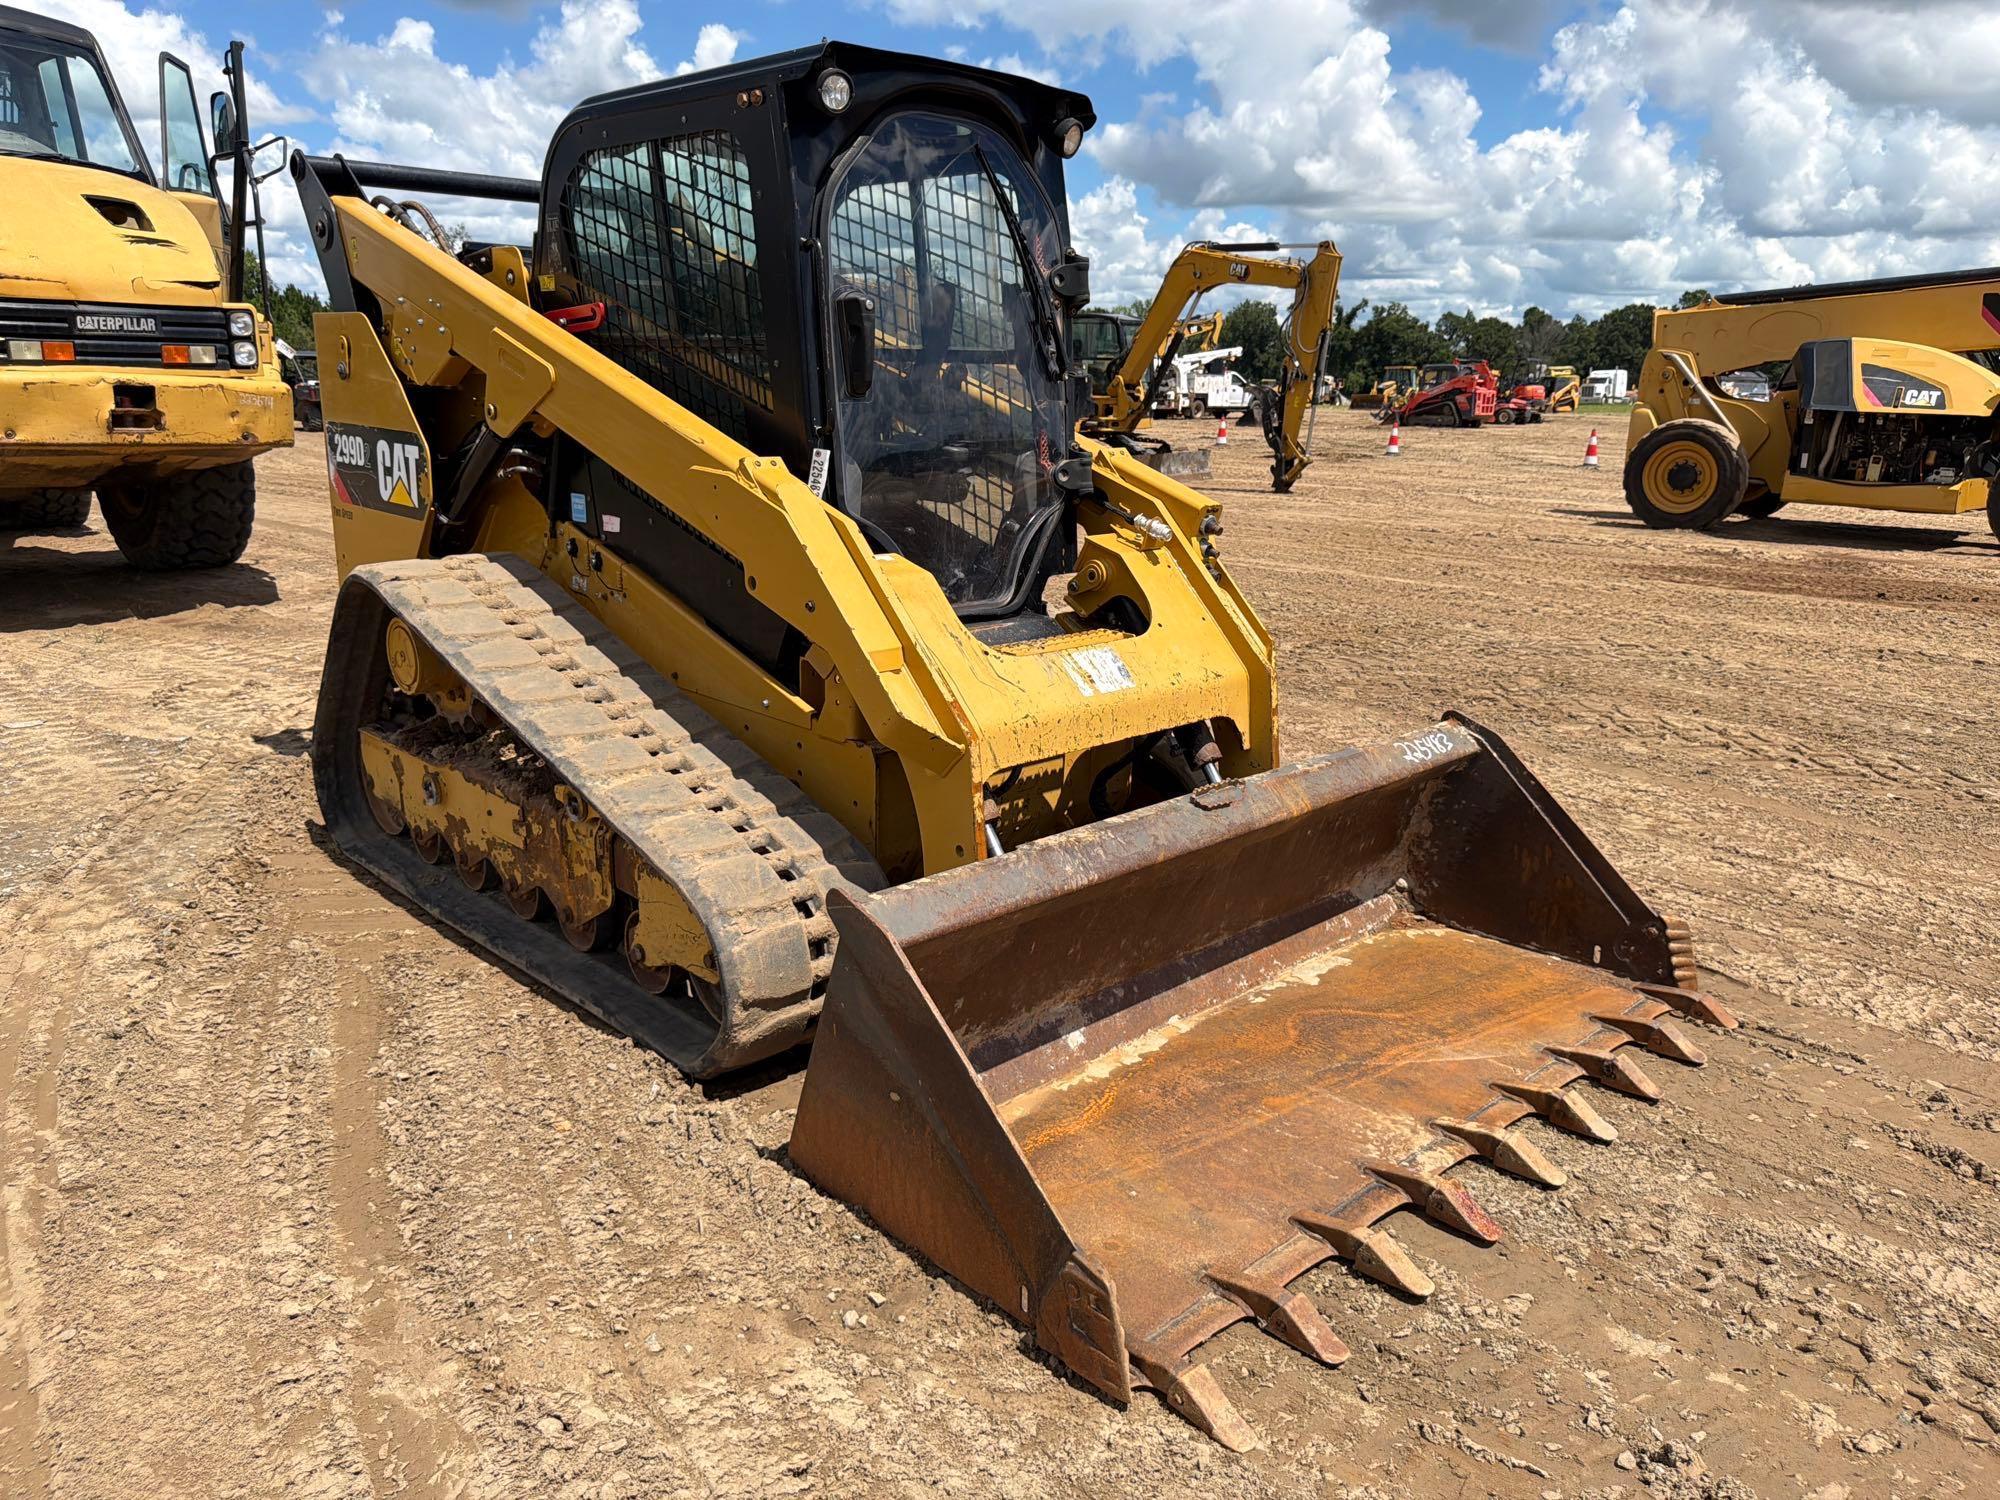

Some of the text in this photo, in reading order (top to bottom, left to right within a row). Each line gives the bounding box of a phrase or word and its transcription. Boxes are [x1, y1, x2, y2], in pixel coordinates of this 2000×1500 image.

[1230, 263, 1248, 277] CAT
[76, 315, 156, 331] CATERPILLAR
[1904, 389, 1941, 406] CAT
[376, 439, 420, 508] CAT
[1392, 733, 1454, 763] 225483
